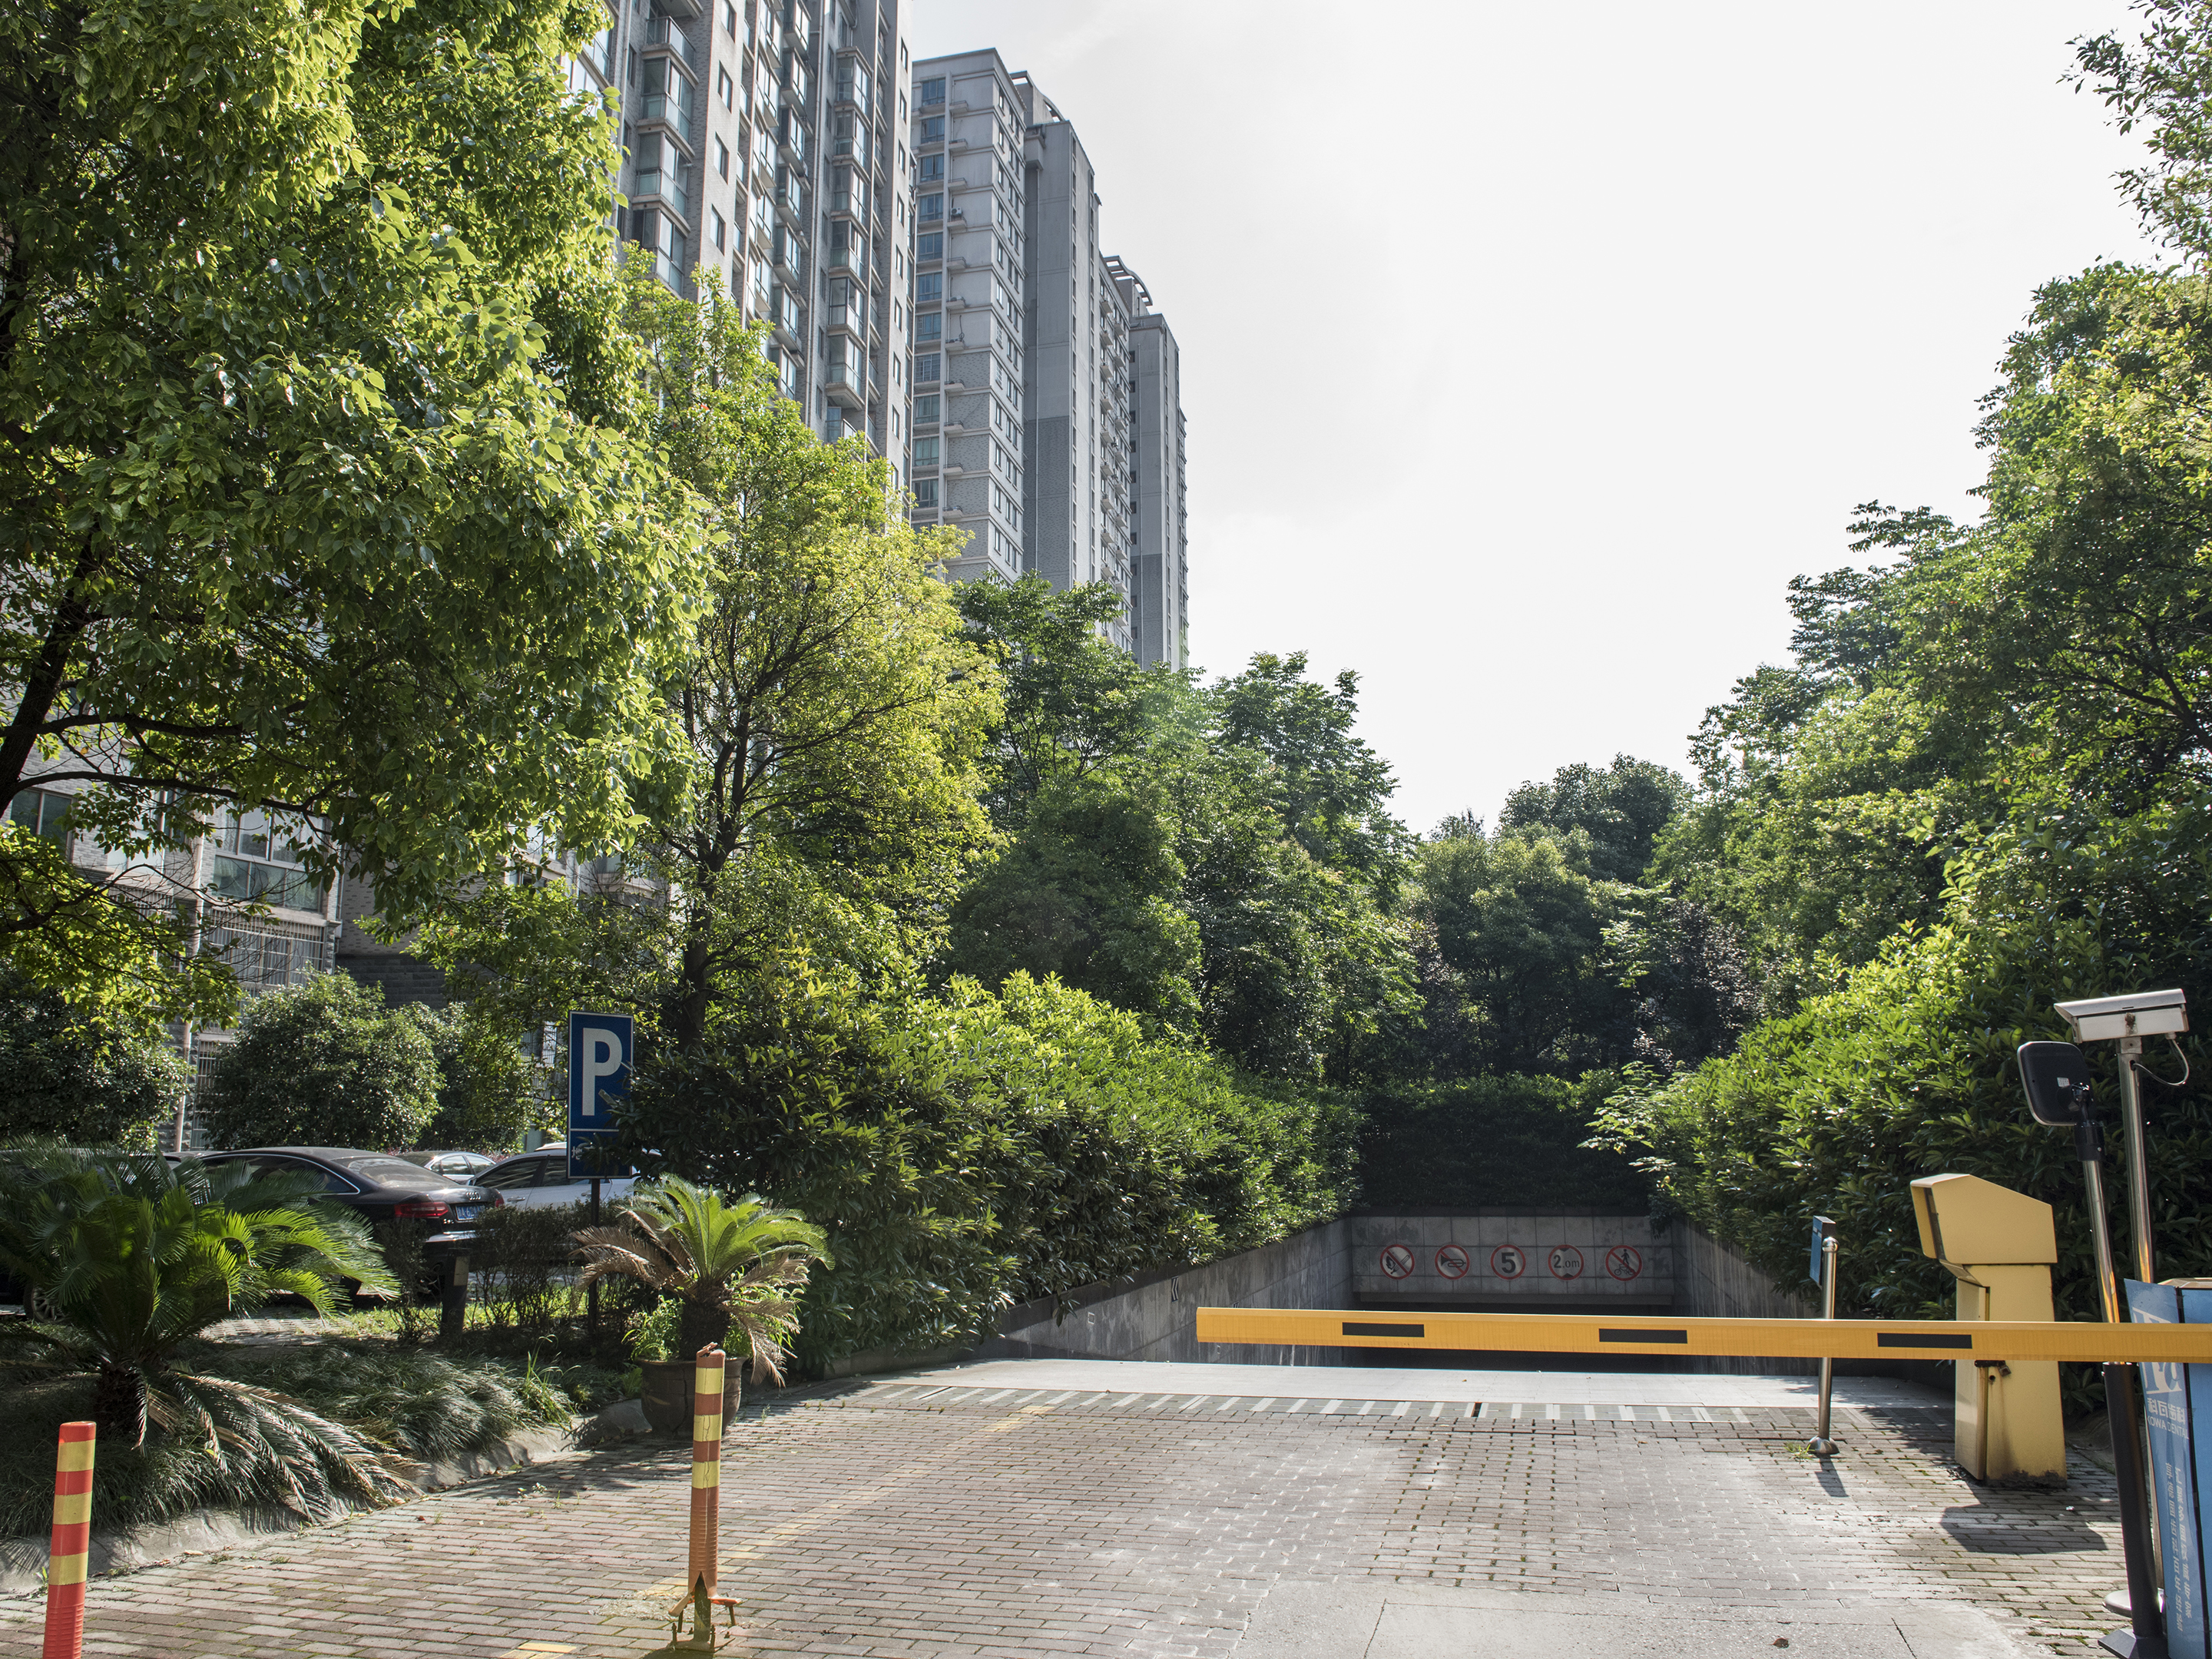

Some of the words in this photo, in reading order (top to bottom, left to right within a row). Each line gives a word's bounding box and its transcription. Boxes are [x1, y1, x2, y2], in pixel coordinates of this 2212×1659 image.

[582, 1028, 623, 1116] P
[1502, 1252, 1516, 1273] 5
[2167, 1422, 2190, 1440] DENTAL
